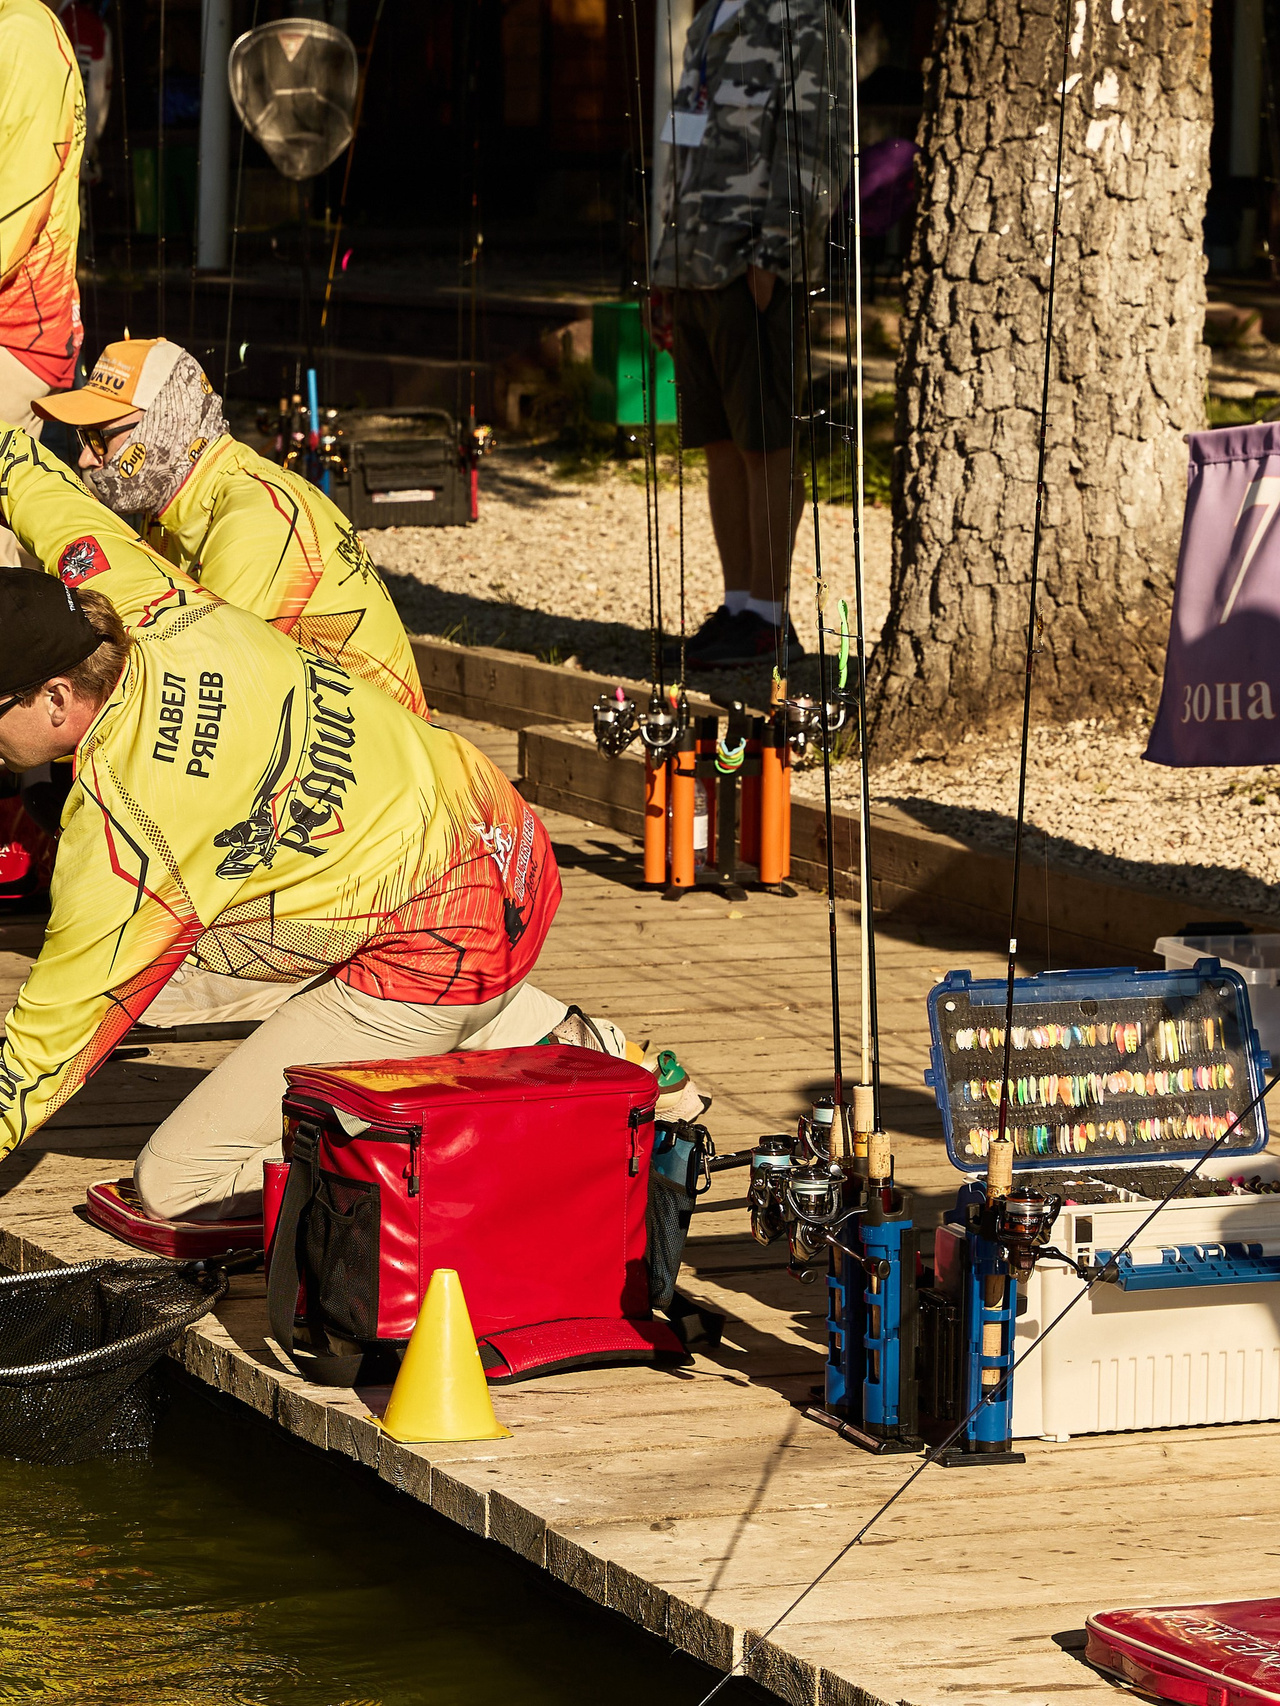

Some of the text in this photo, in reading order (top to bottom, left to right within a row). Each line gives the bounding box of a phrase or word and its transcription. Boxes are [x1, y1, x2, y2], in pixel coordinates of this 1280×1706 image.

[121, 444, 145, 477] Buff
[152, 671, 187, 764] ПАВЕЛ
[185, 671, 227, 779] РЯБЦЕВ
